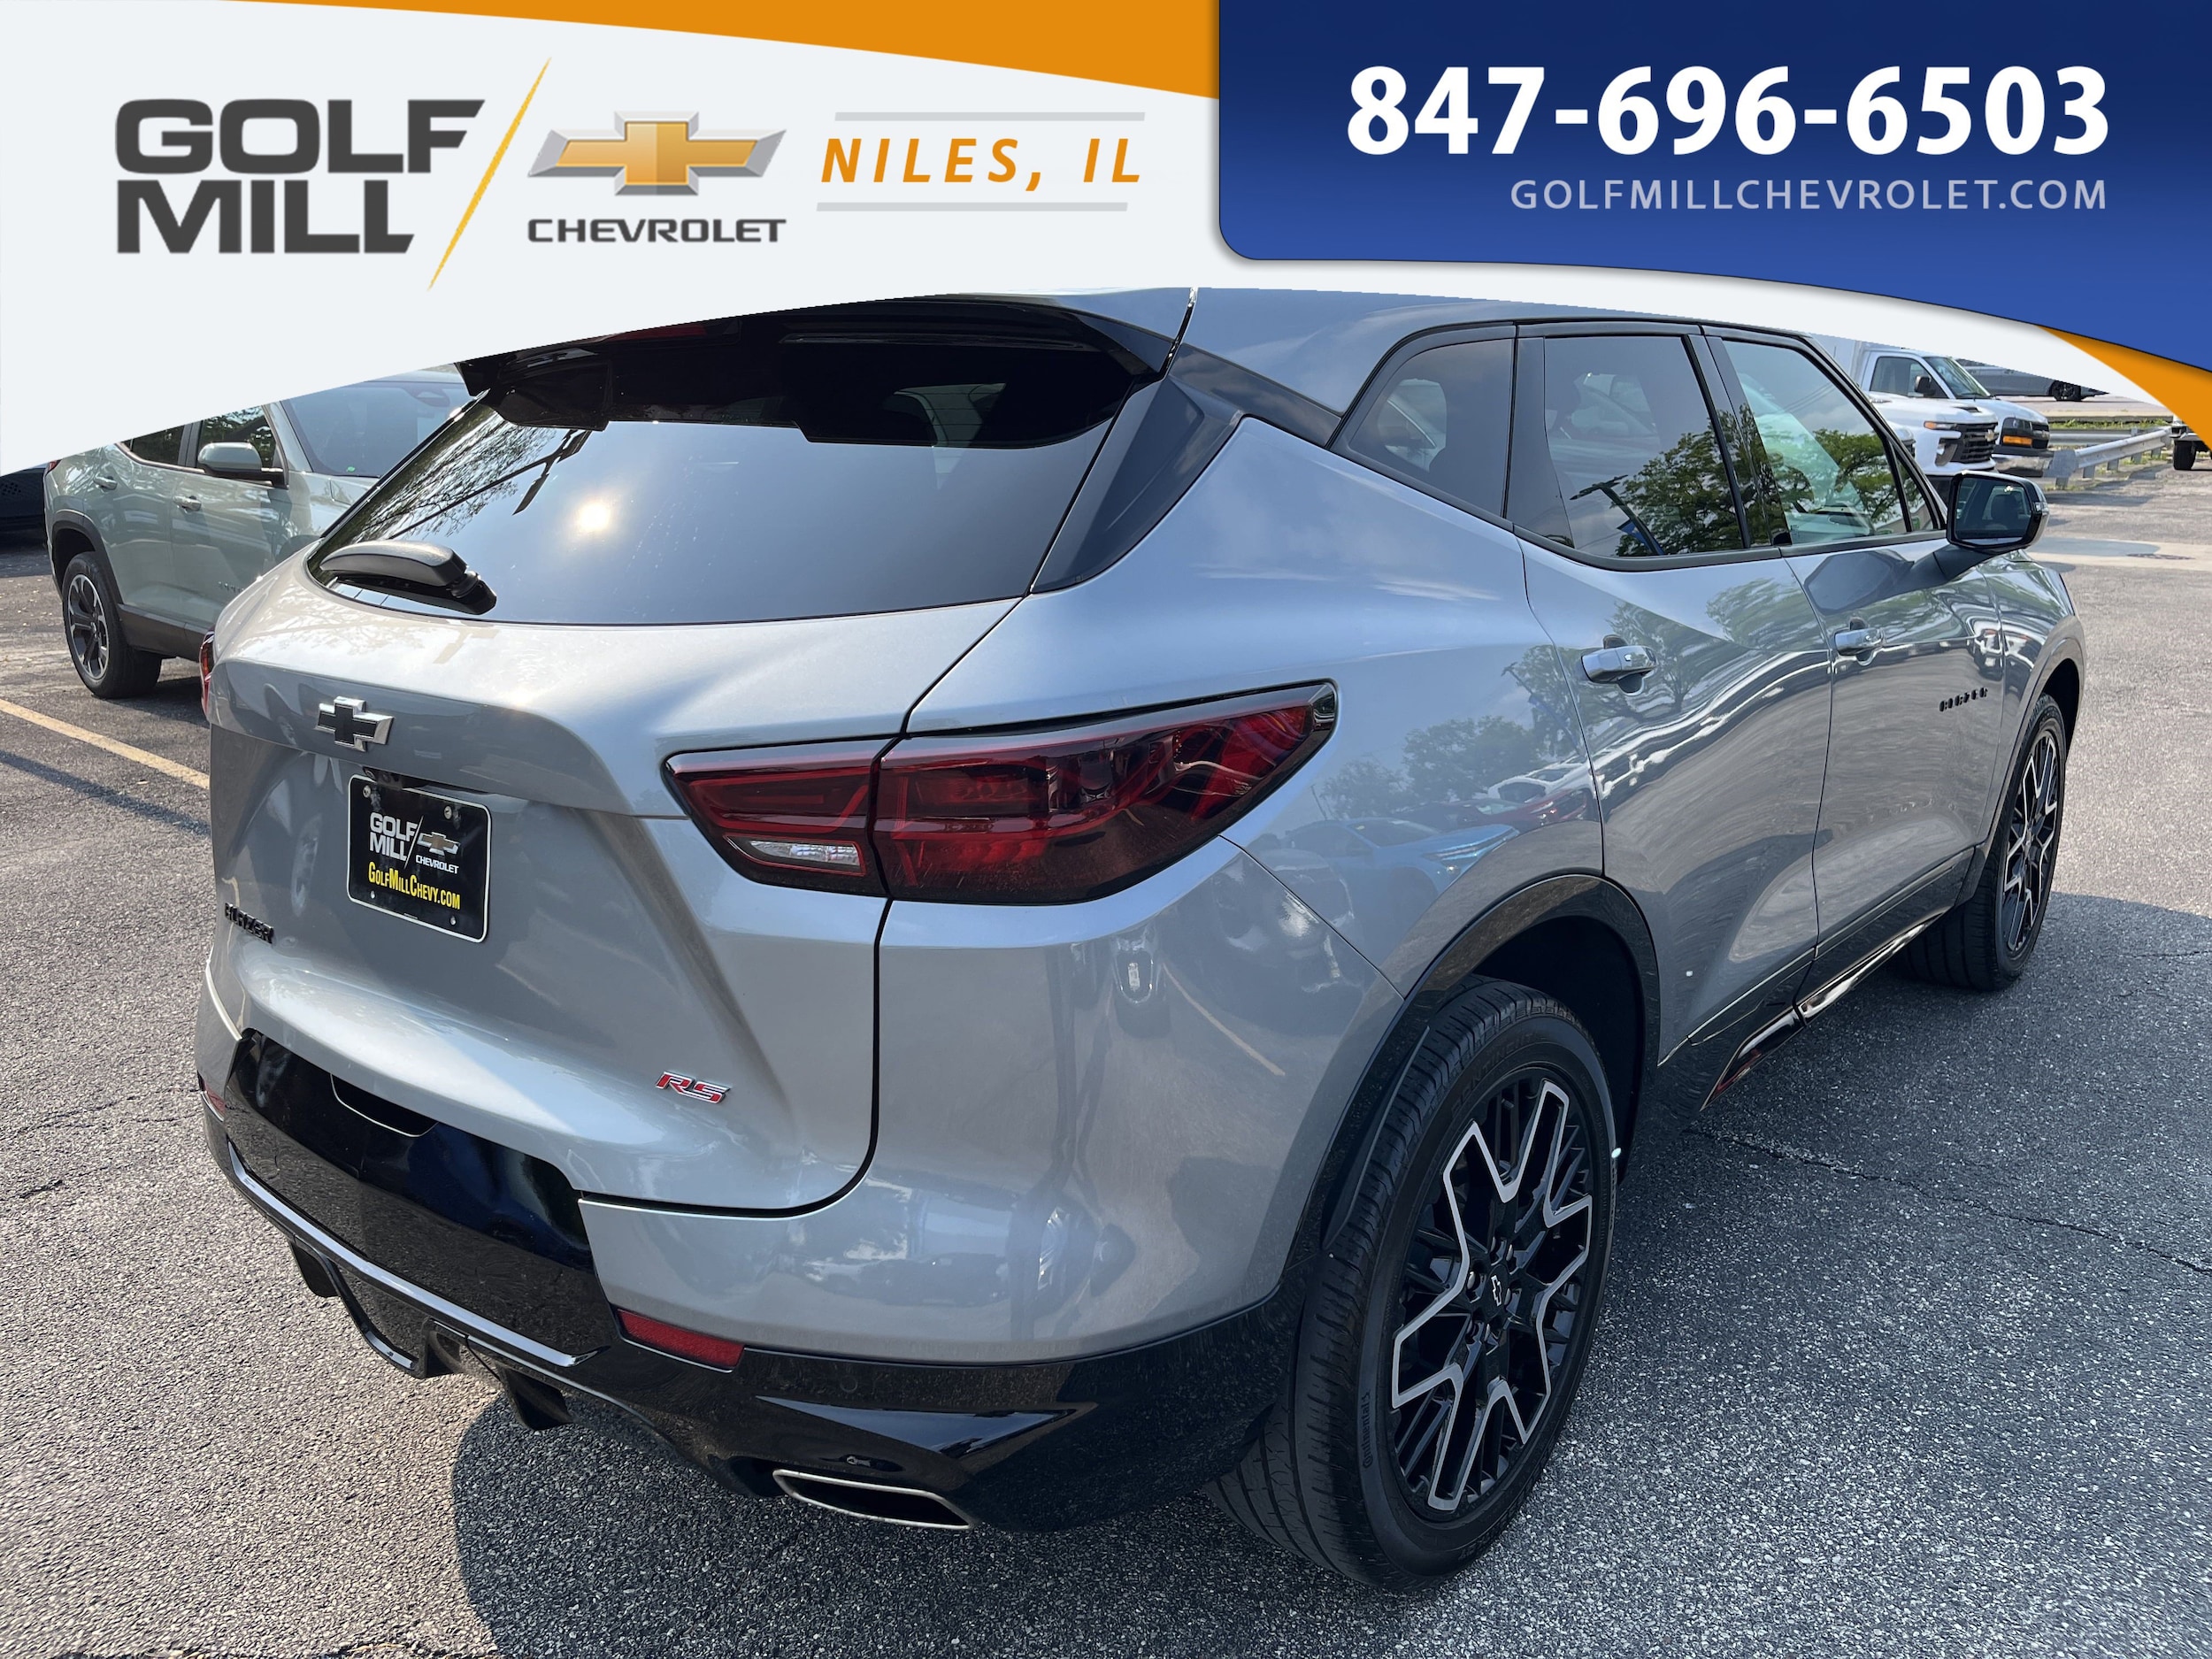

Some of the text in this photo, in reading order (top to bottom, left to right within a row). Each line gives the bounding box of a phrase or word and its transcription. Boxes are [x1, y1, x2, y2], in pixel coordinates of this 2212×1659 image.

[370, 812, 418, 841] GOLF
[370, 833, 407, 861] MILL
[416, 855, 459, 873] CHEVROLET
[656, 1070, 731, 1103] RS
